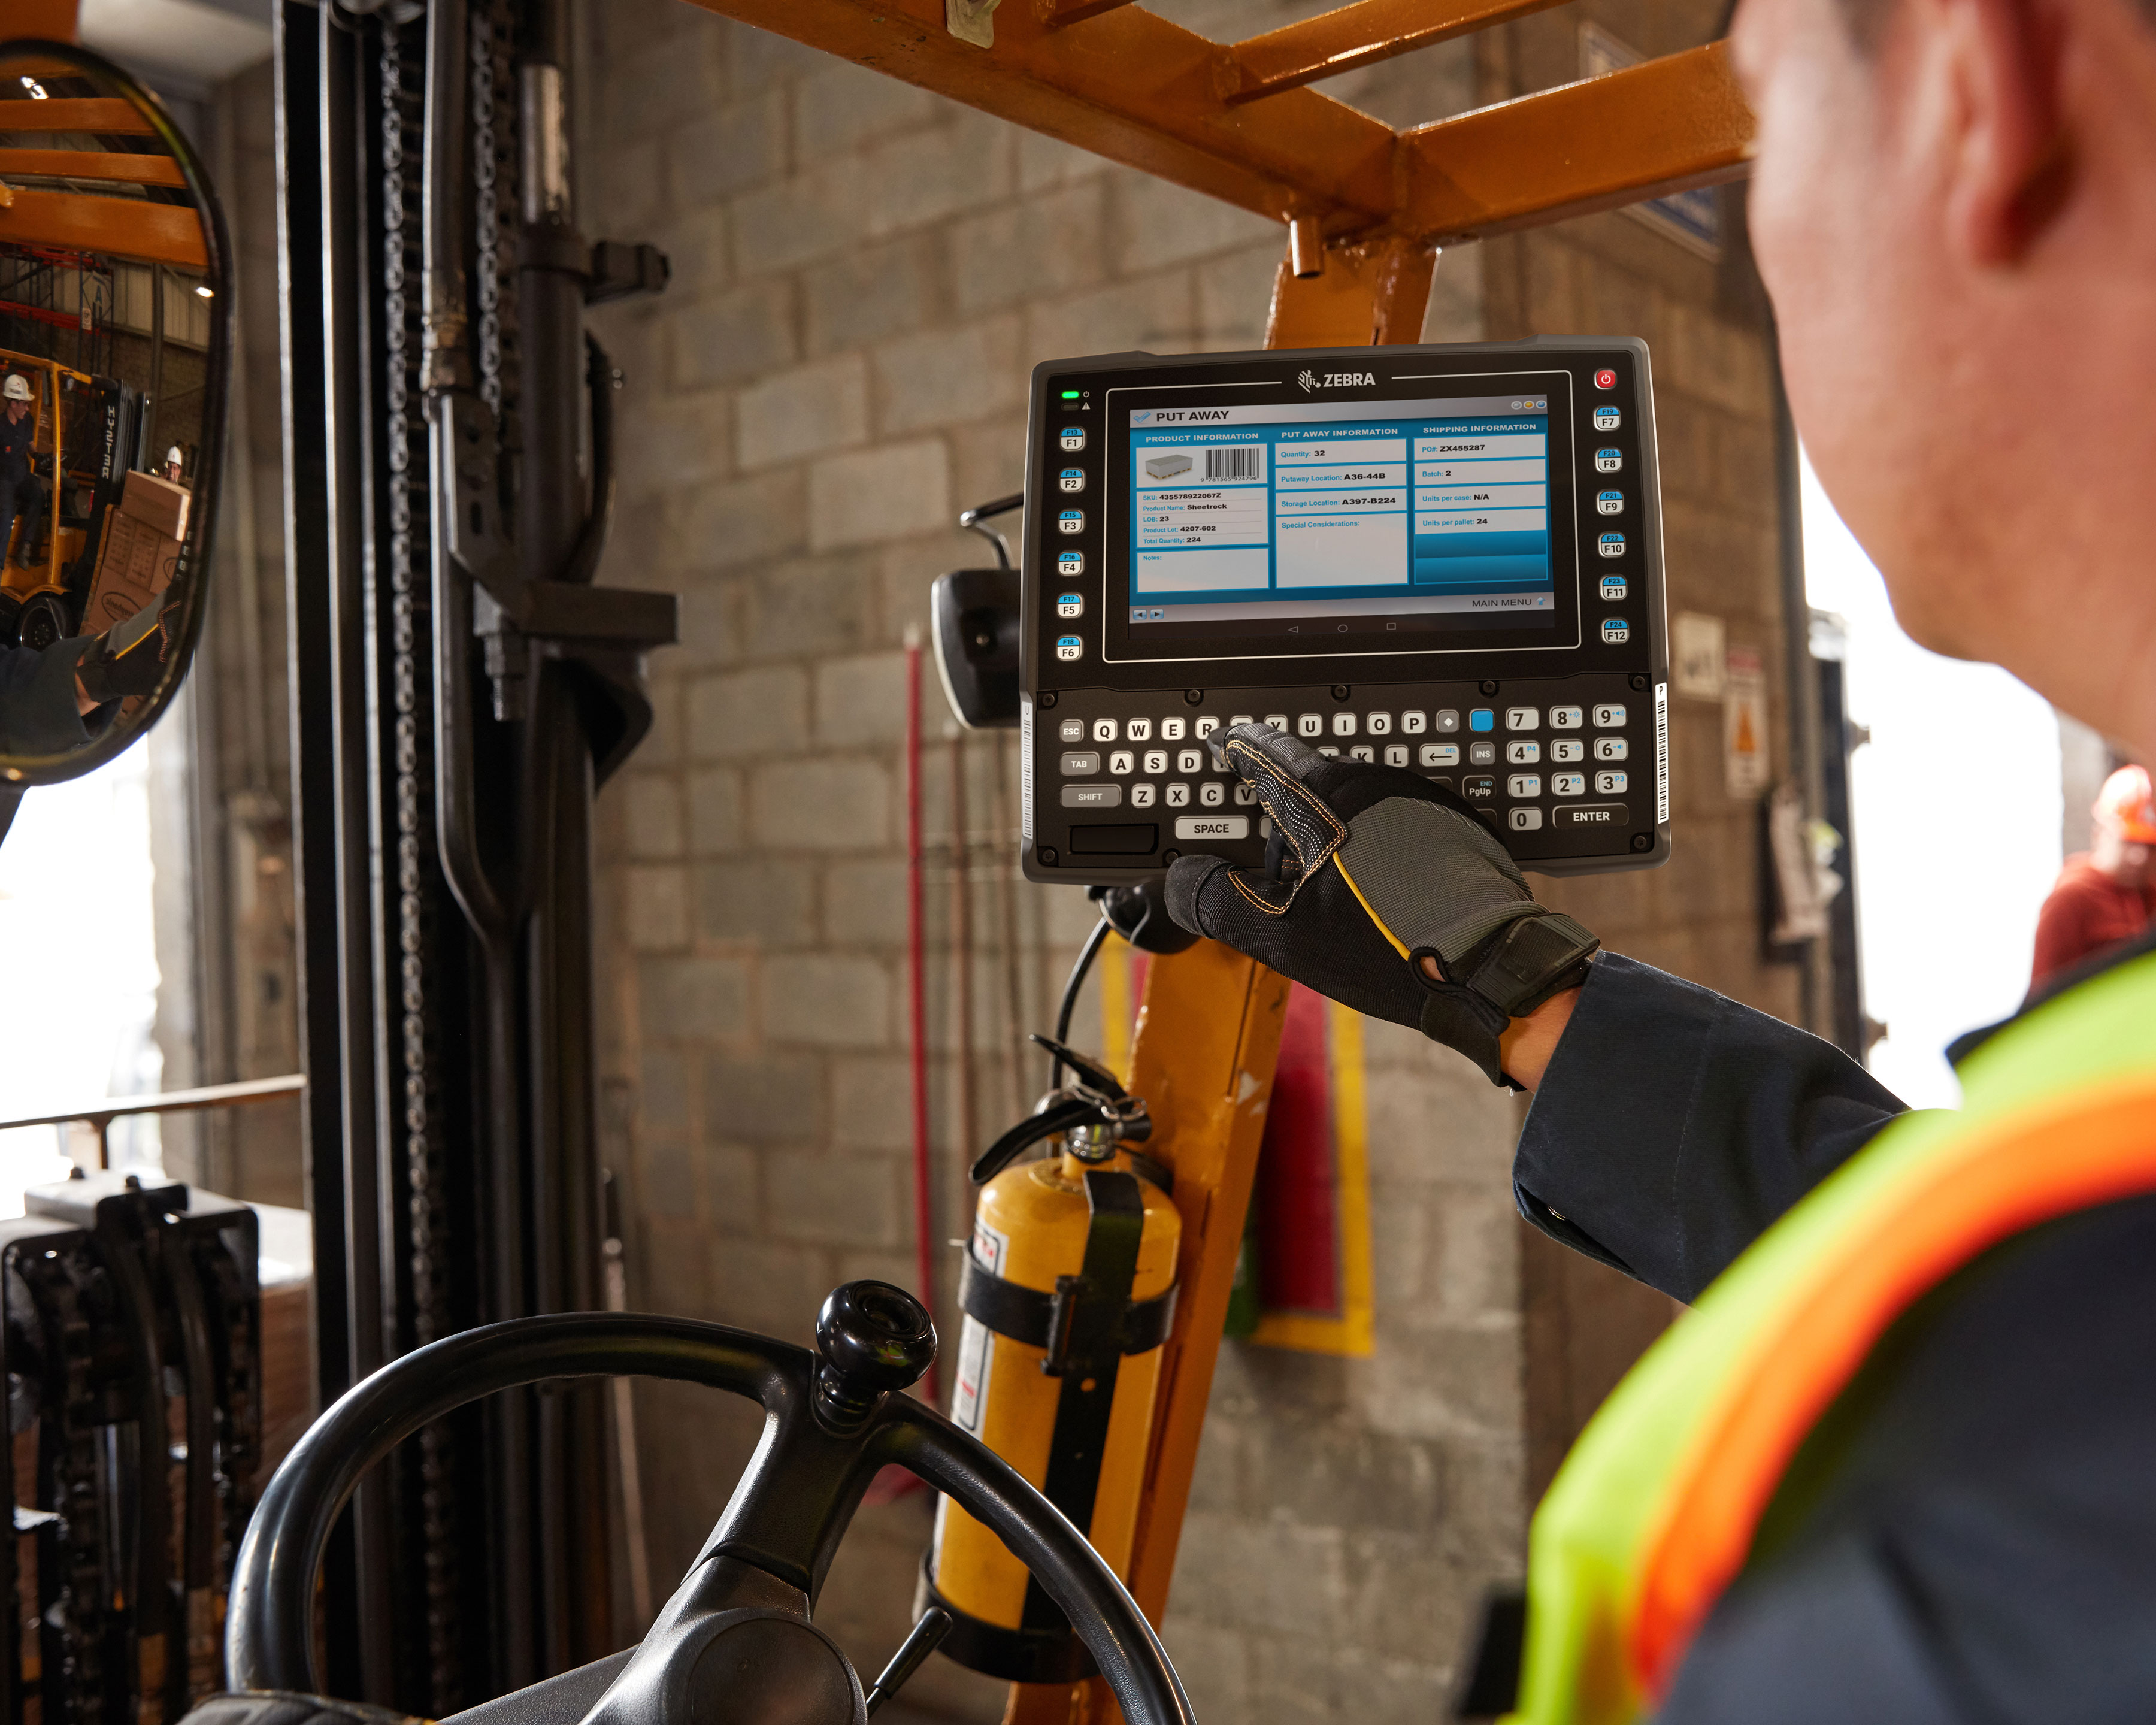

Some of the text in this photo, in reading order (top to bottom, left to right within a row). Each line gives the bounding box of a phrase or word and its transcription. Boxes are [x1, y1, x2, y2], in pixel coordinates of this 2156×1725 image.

[1323, 373, 1376, 387] ZEBRA
[1156, 411, 1229, 422] PUT AWAY
[1333, 428, 1398, 437] INFORMATION
[1065, 480, 1077, 488] F2
[1606, 503, 1618, 511] F9
[1064, 522, 1076, 530] F3
[1604, 544, 1622, 553] F10
[1064, 564, 1075, 572] F4
[1607, 588, 1624, 597] F11
[1607, 632, 1626, 640] F12
[1062, 649, 1074, 657] F6
[1513, 713, 1524, 727] 7
[1558, 711, 1567, 725] 8
[1601, 709, 1611, 724] 9
[1168, 724, 1177, 736] E
[1203, 724, 1212, 736] R
[1306, 721, 1315, 733] U
[1343, 719, 1347, 732] I
[1374, 718, 1385, 731] O
[1409, 718, 1419, 730] P
[1100, 725, 1110, 738] Q
[1132, 725, 1146, 737] W
[1515, 747, 1525, 760] 4
[1558, 745, 1568, 758] 5
[1602, 743, 1613, 756] 6
[1116, 758, 1127, 770] A
[1150, 757, 1160, 770] S
[1185, 757, 1194, 769] D
[1393, 752, 1401, 764] L
[1516, 780, 1524, 794] 1
[1559, 778, 1570, 792] 2
[1603, 776, 1614, 790] 3
[1138, 791, 1147, 803] Z
[1172, 790, 1182, 803] X
[1206, 789, 1216, 802] C
[1241, 789, 1252, 801] V
[1469, 788, 1491, 797] PgUp
[1516, 813, 1527, 827] 0
[1573, 812, 1610, 822] ENTER
[1194, 824, 1230, 834] SPACE
